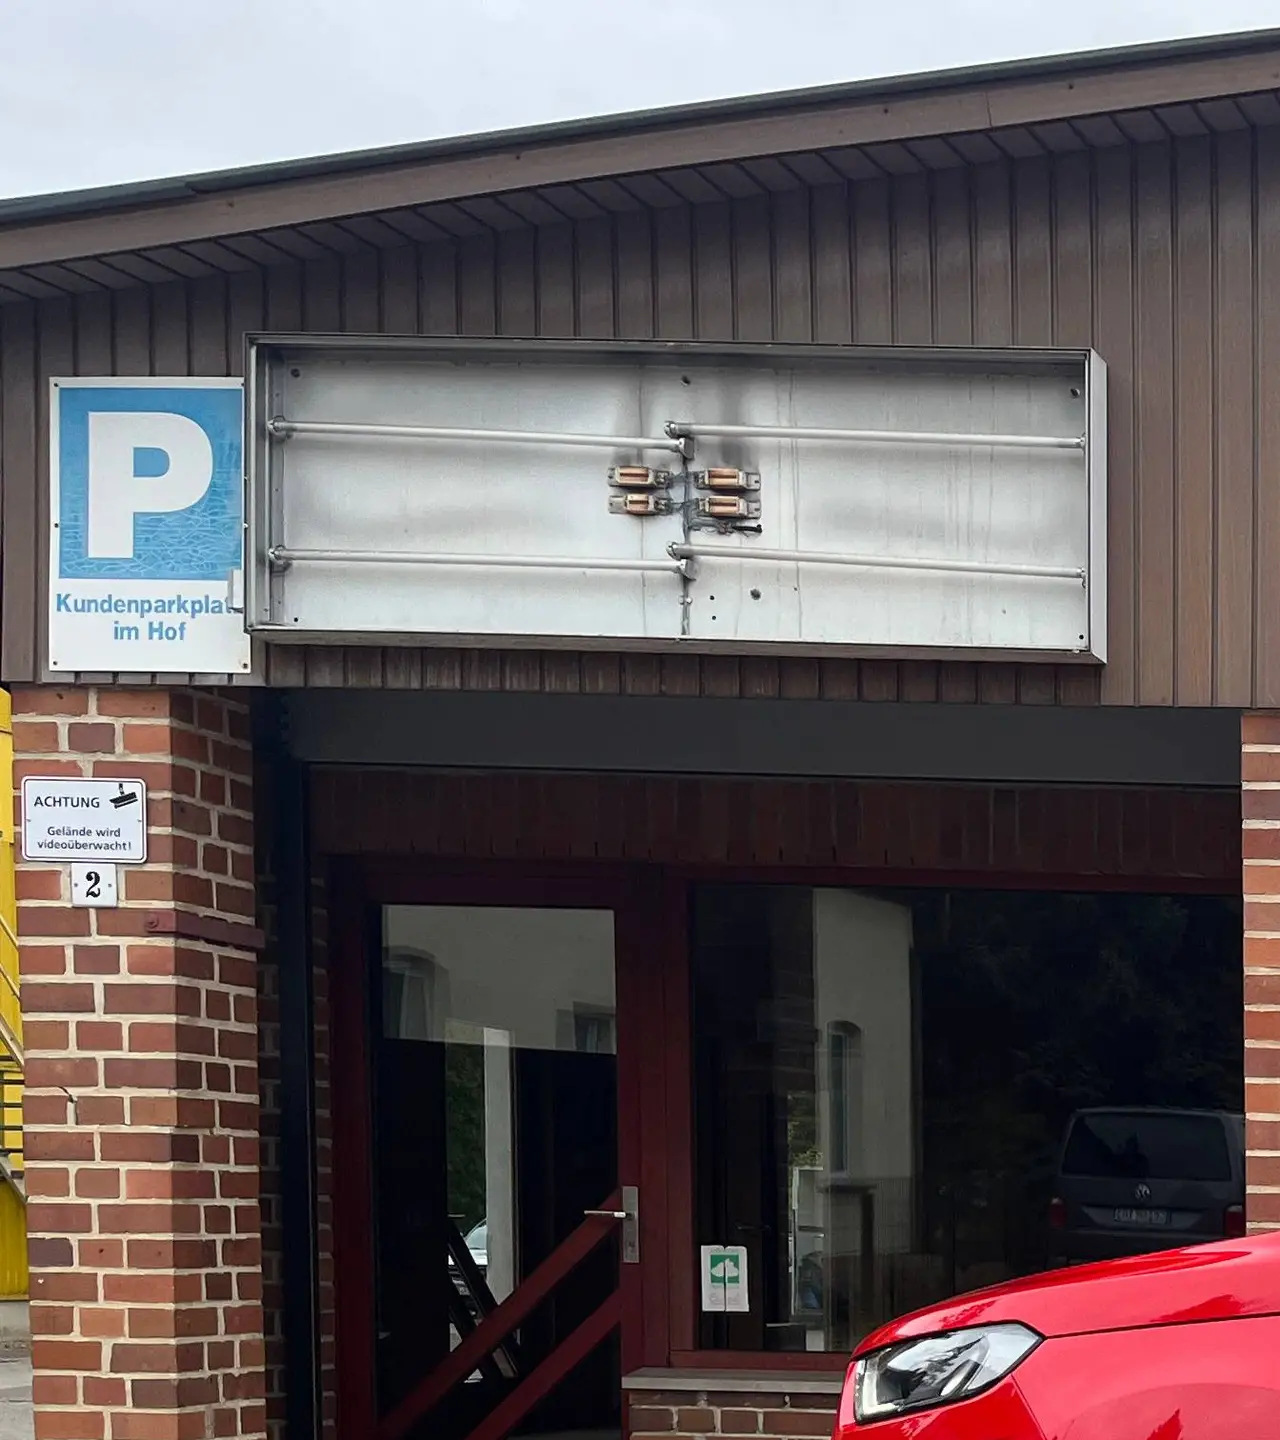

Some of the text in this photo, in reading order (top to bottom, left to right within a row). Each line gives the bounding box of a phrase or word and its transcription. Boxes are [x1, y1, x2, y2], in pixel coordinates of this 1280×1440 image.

[88, 411, 213, 559] P
[56, 593, 243, 618] Kundenparkplat
[113, 620, 187, 641] im Hof
[33, 796, 100, 808] ACHTUNG
[47, 826, 121, 837] Gelände wird
[37, 840, 131, 851] videoüberwacht!
[85, 871, 101, 898] 2
